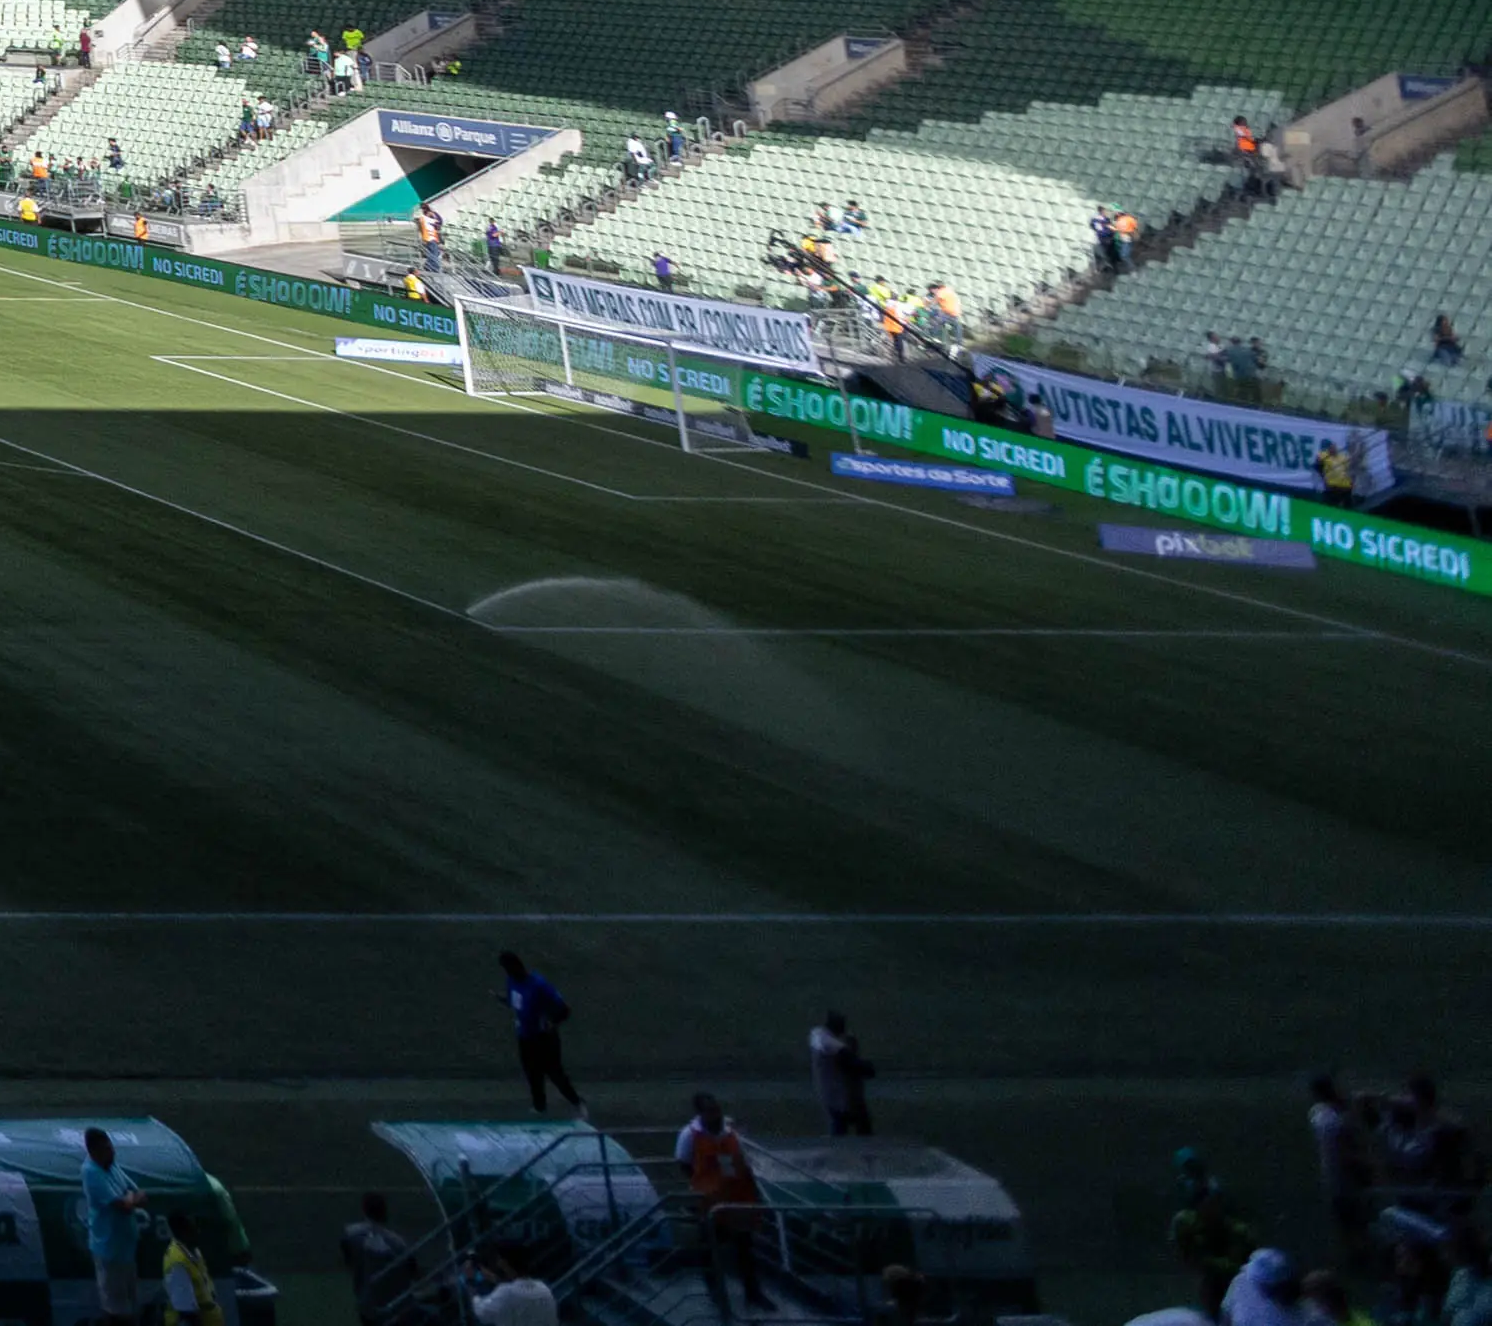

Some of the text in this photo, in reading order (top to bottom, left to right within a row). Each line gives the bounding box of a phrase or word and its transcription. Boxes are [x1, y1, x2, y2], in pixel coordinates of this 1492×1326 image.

[390, 118, 497, 146] Allianz Parque
[153, 256, 224, 286] NO SICREDI
[373, 302, 396, 323] NO
[1036, 381, 1158, 444] AUTISTAS
[943, 428, 1066, 479] NO SICREDI
[1310, 516, 1470, 581] NO SICREDI
